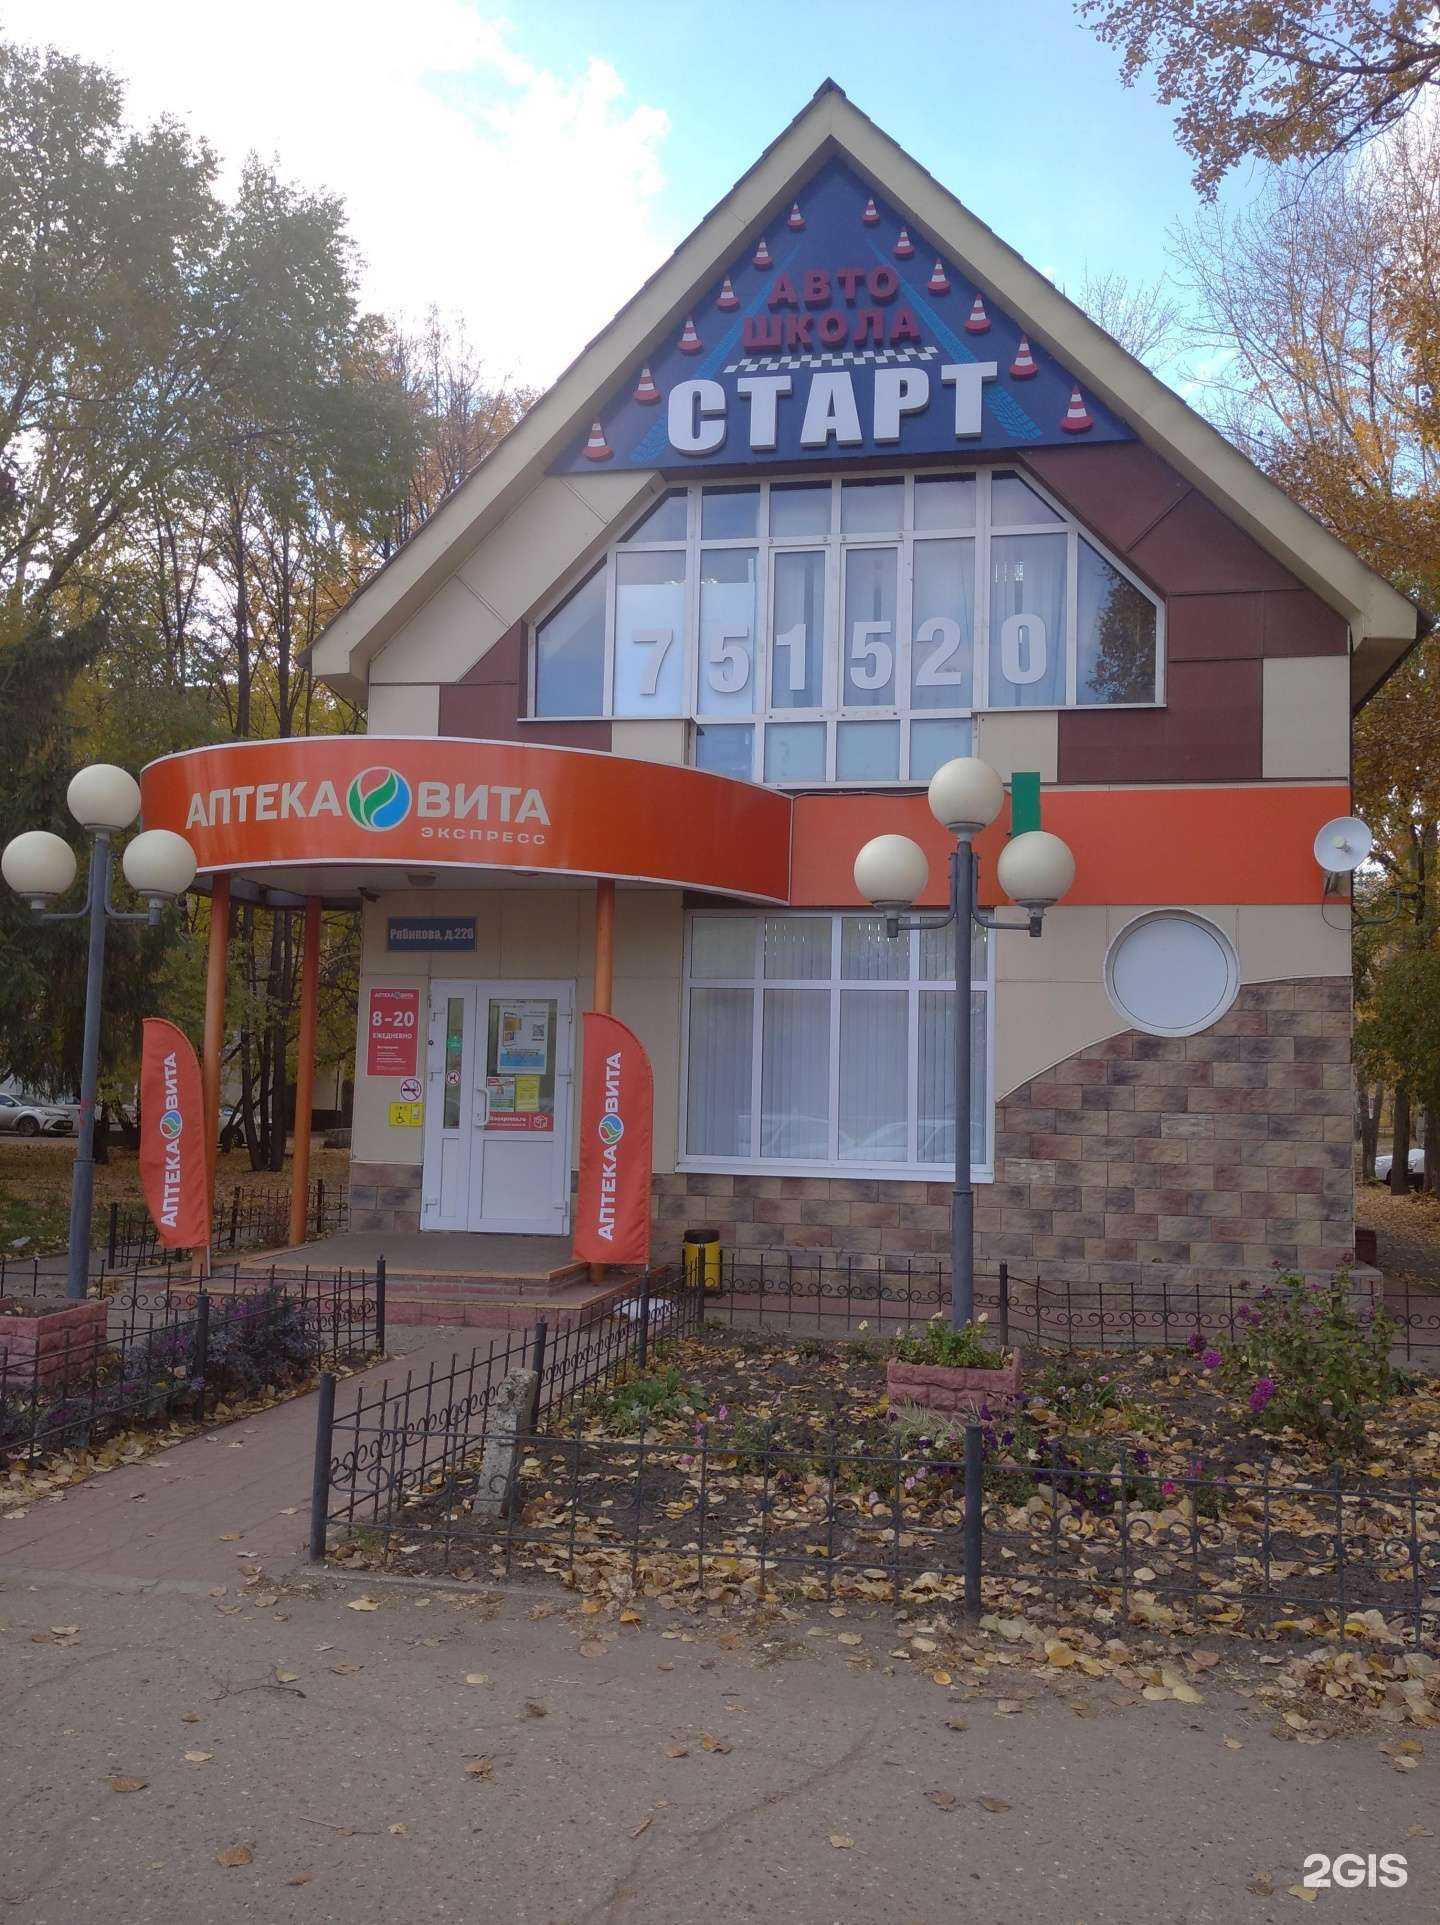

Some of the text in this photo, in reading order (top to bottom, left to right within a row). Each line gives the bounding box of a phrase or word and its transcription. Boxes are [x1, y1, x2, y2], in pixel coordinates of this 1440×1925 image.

[767, 266, 900, 308] АВТО
[741, 308, 922, 352] ШКОЛА
[667, 361, 999, 457] СТАРТ
[185, 780, 552, 830] АПТЕКА ВИТА
[420, 826, 546, 845] ЭКСПРЕСС
[160, 1052, 181, 1228] АПТЕКА ВИТА
[597, 1052, 622, 1241] АПТЕКА ВИТА
